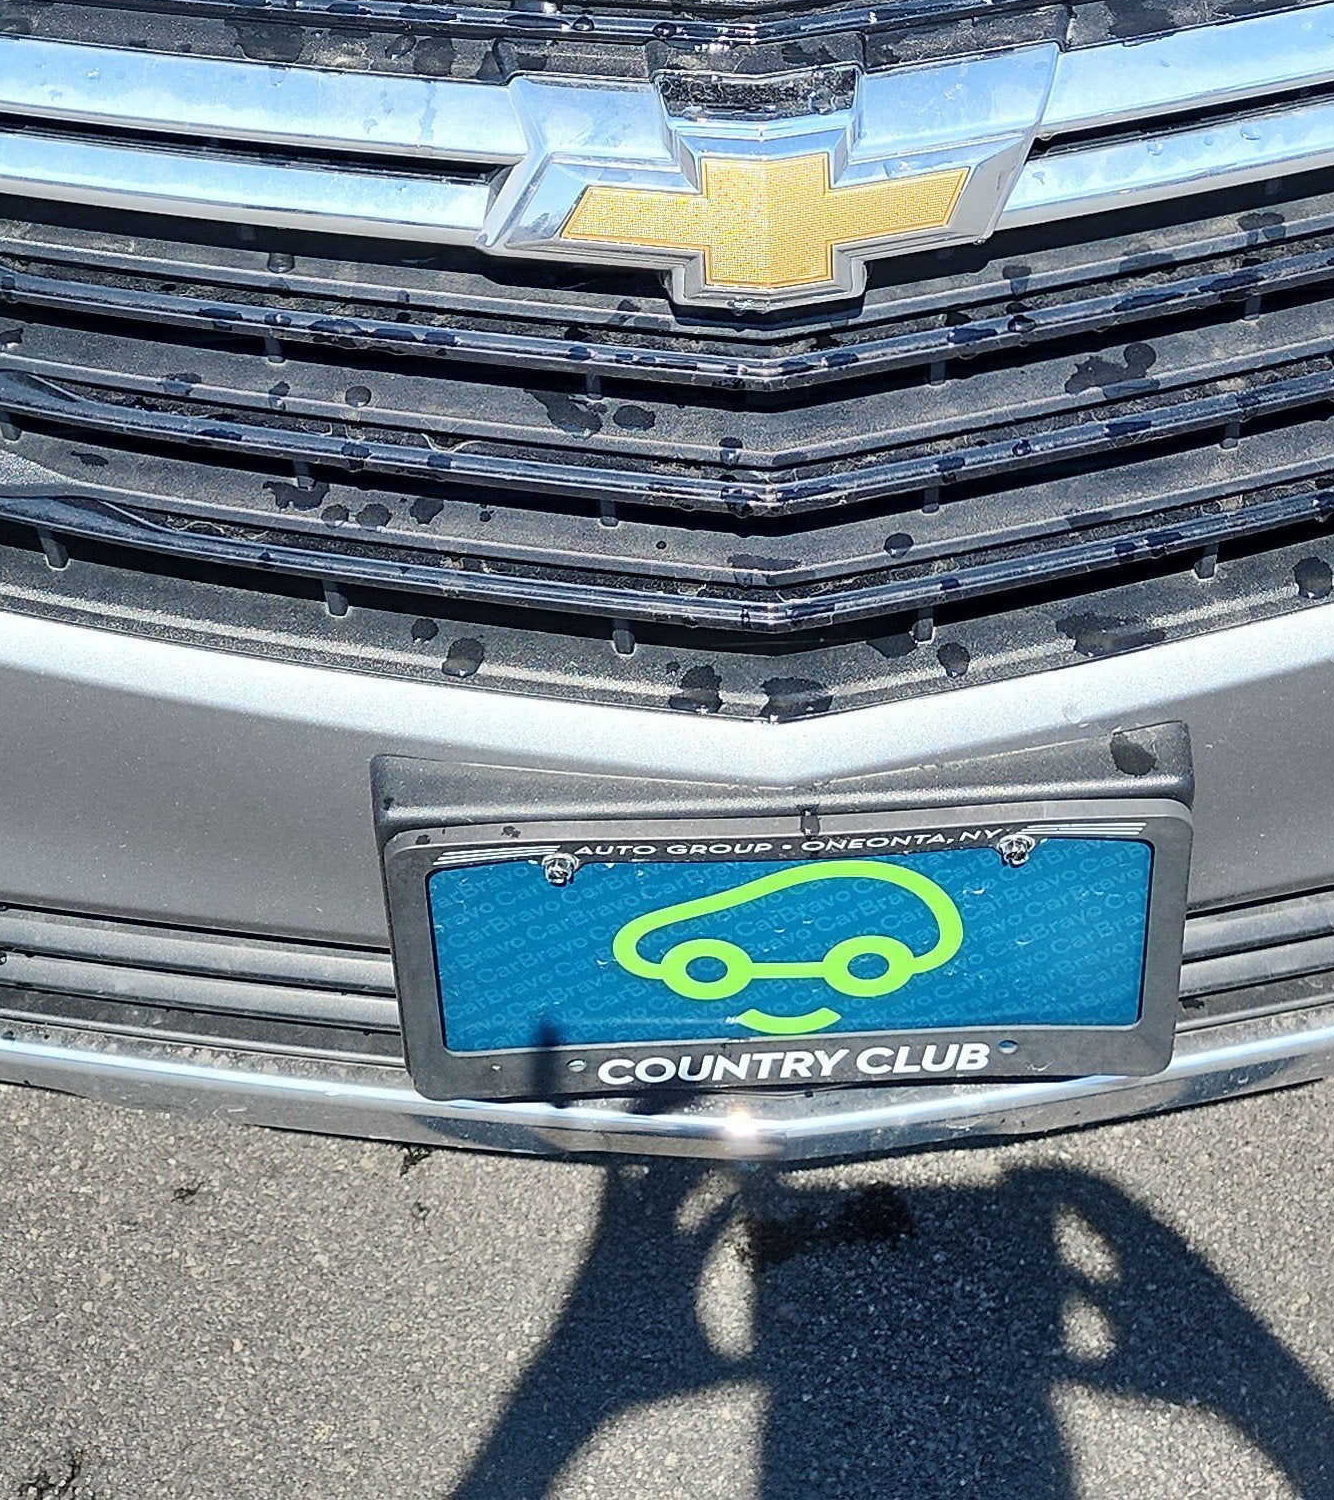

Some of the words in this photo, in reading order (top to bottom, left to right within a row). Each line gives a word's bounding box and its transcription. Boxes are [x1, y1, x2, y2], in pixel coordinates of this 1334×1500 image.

[574, 845, 657, 856] AUTO
[666, 843, 773, 856] GROUP
[801, 832, 954, 852] ONEONTA,
[959, 828, 1004, 842] NY
[597, 1048, 849, 1086] COUNTRY
[855, 1043, 990, 1076] CLUB
